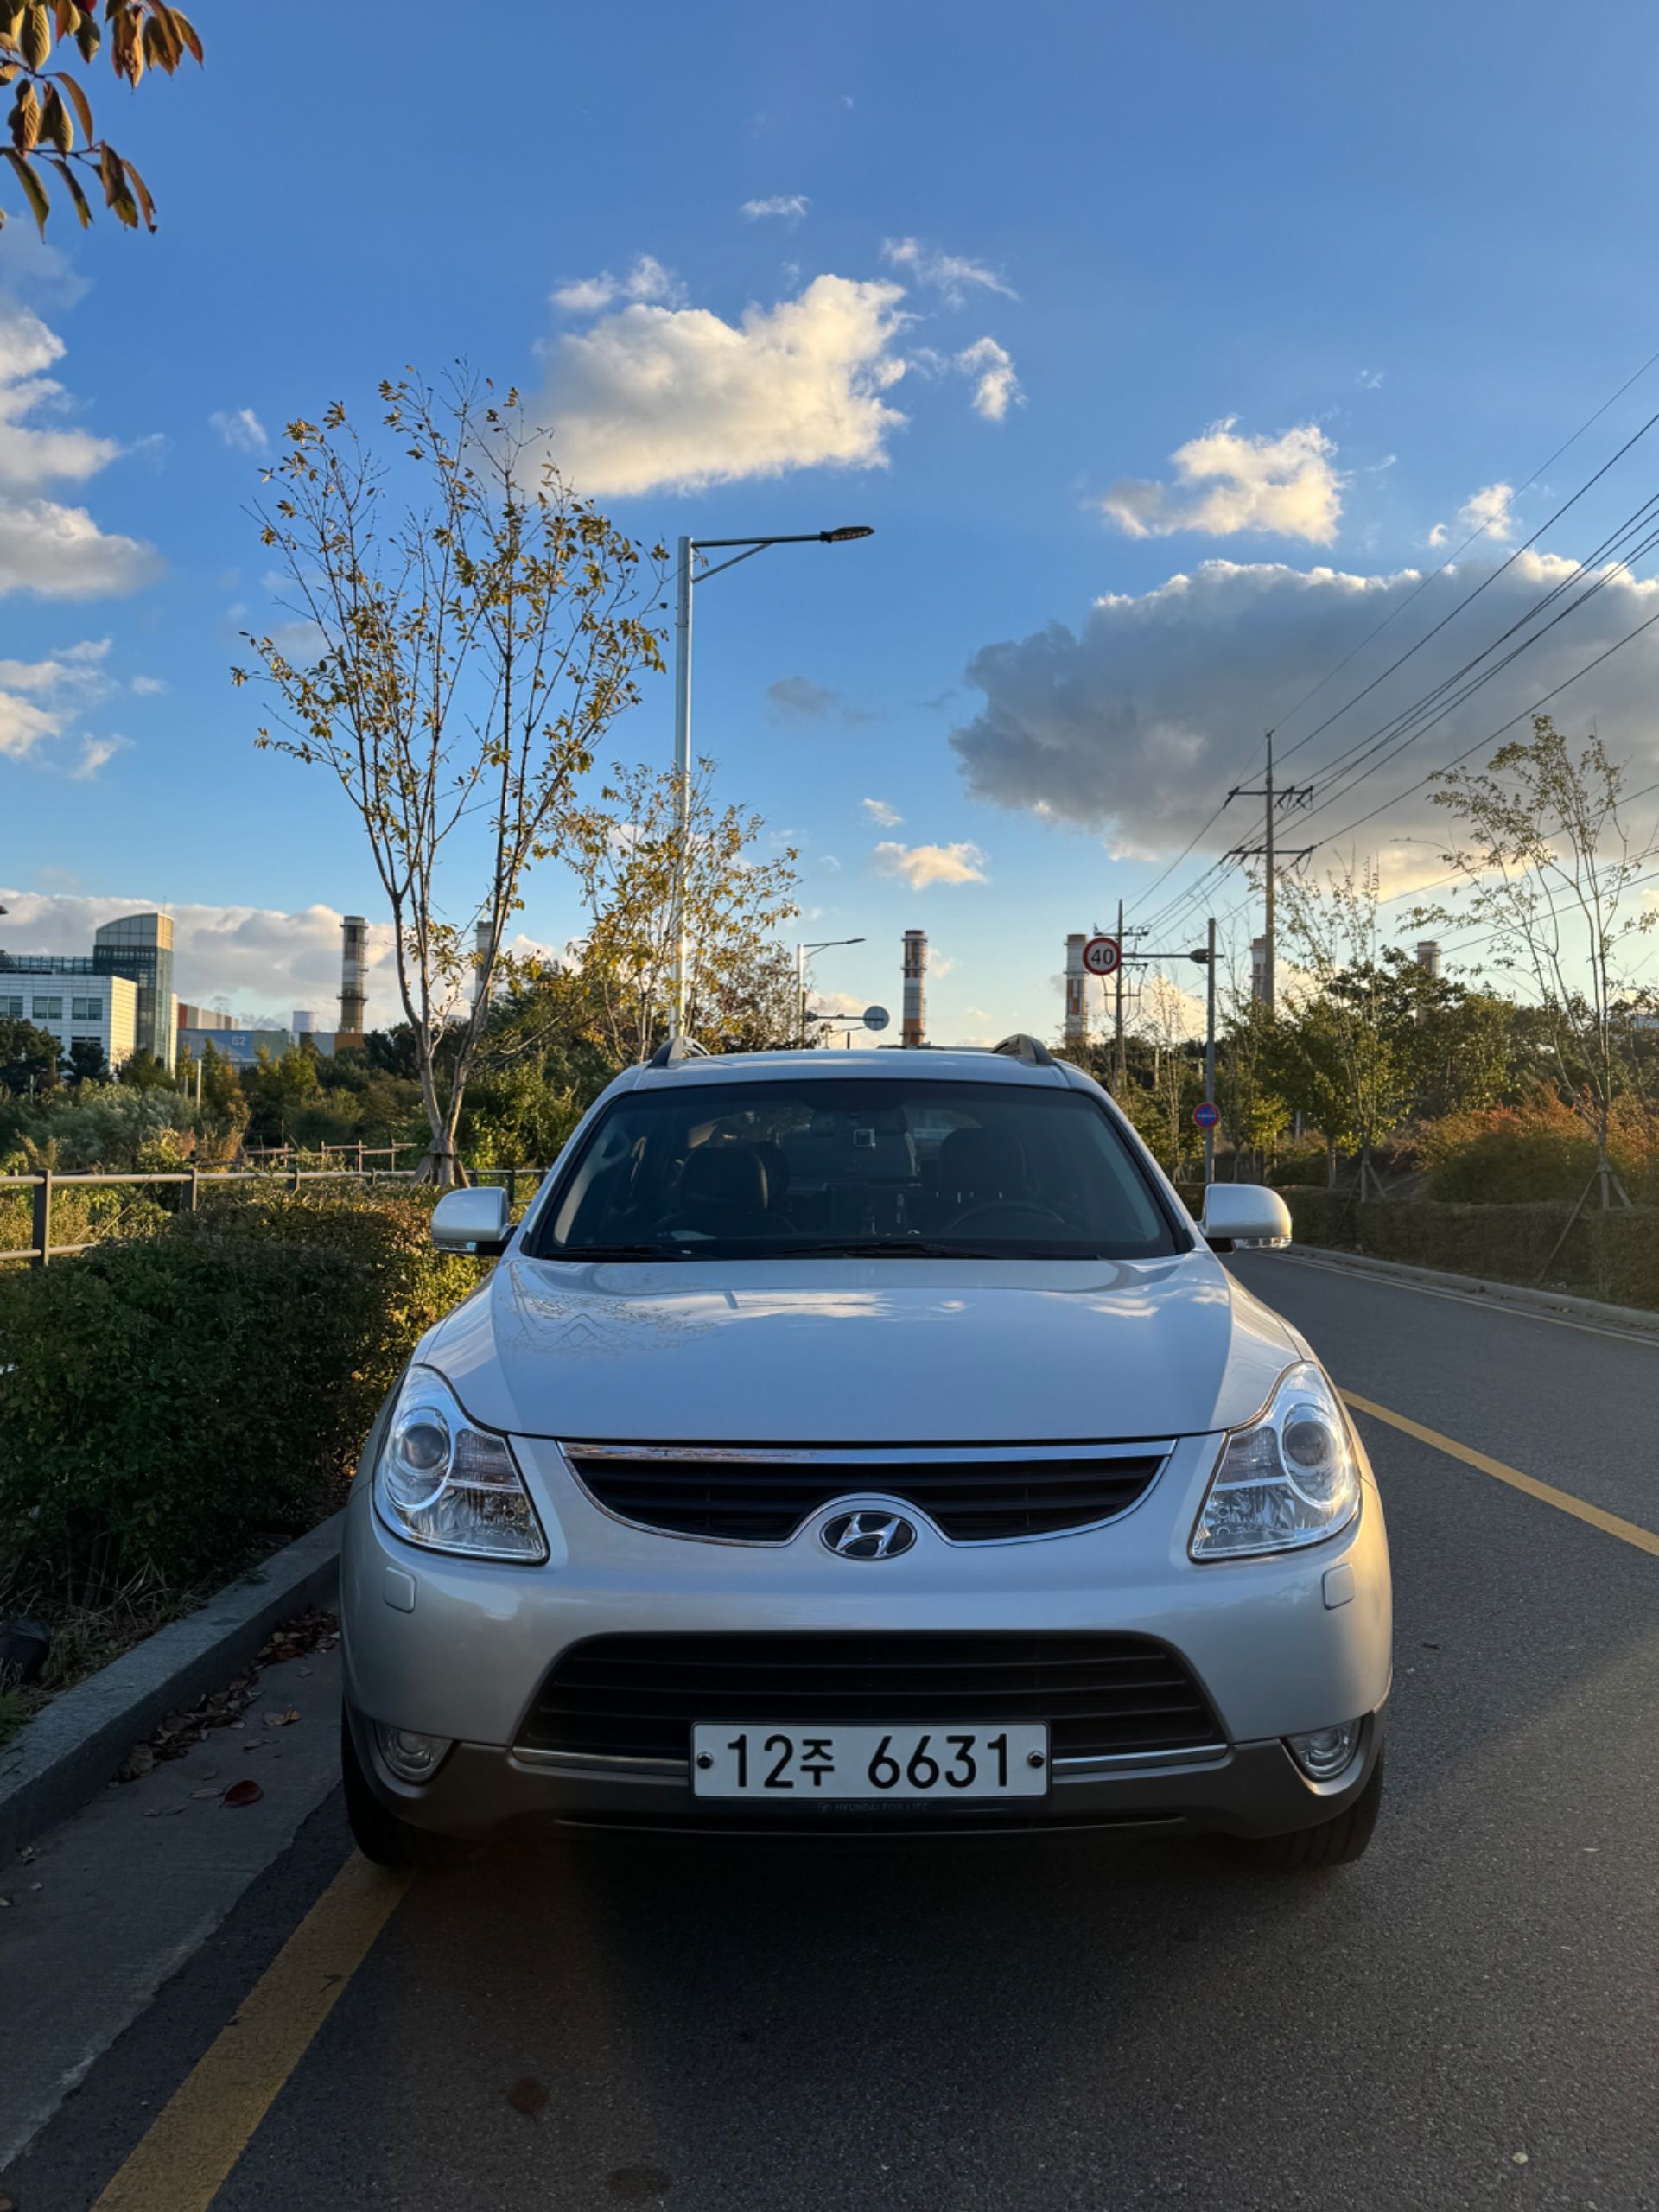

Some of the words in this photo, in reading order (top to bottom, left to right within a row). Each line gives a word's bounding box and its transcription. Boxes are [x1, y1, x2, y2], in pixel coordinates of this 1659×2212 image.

[1091, 948, 1114, 965] 40
[728, 1733, 835, 1789] 12주
[868, 1733, 1007, 1789] 6631
